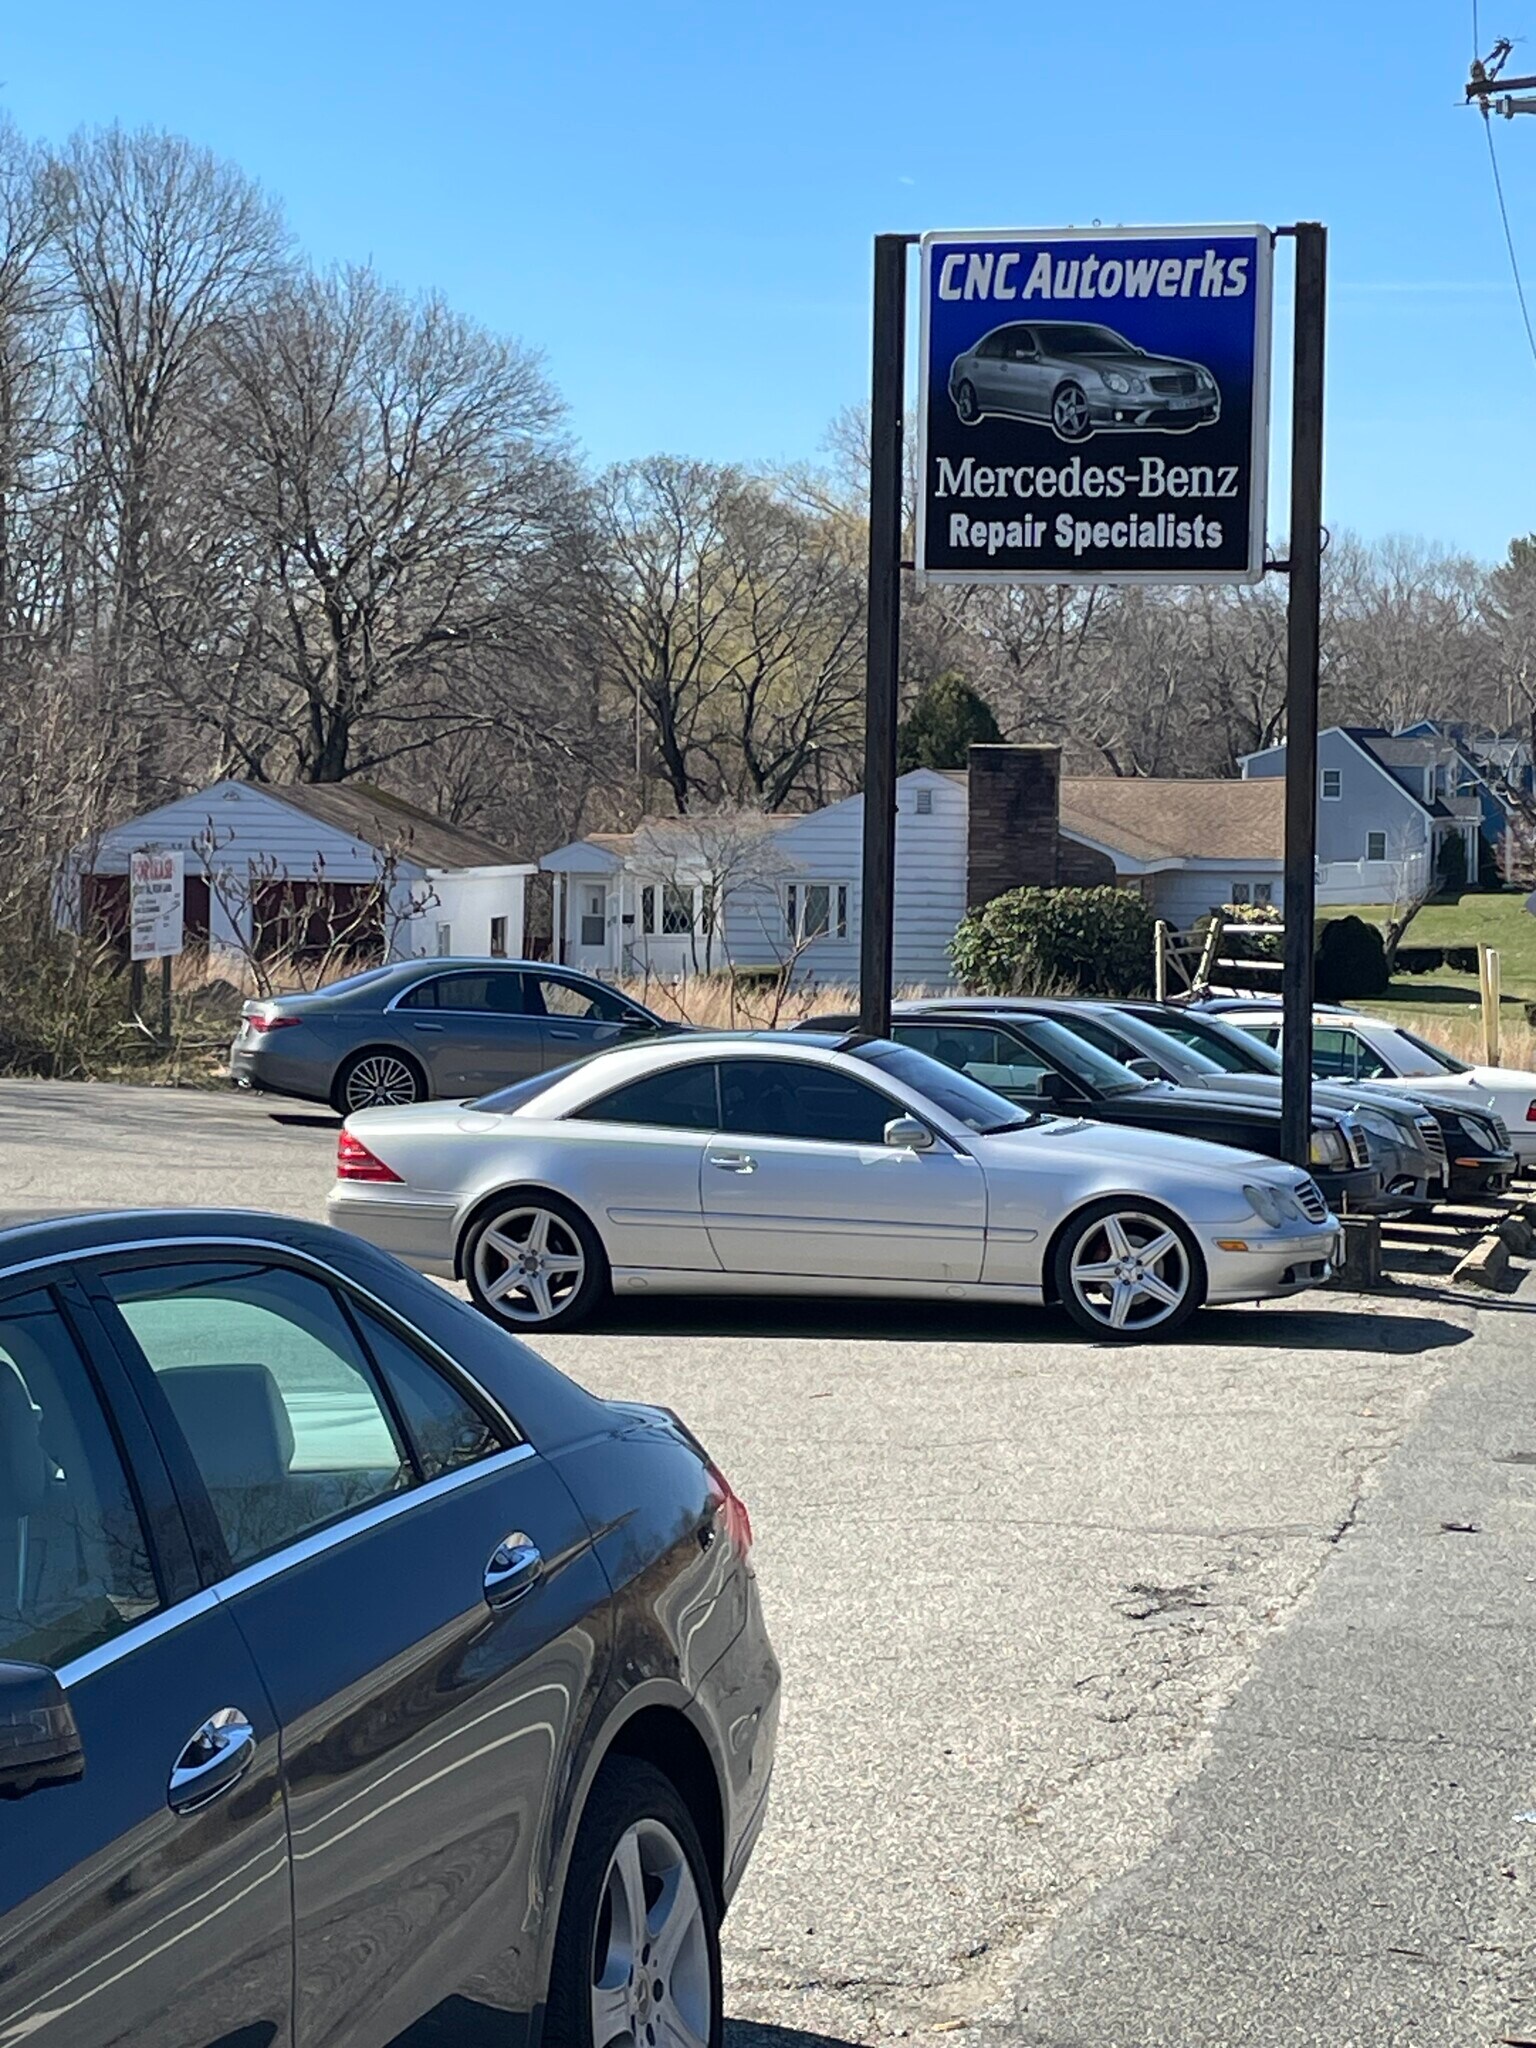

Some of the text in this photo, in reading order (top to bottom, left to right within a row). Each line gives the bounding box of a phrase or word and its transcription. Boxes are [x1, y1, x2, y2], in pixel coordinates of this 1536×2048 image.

[938, 249, 1249, 300] CNC Autowerks
[934, 456, 1239, 498] Mercedes-Benz
[949, 513, 1223, 556] Repair Specialists
